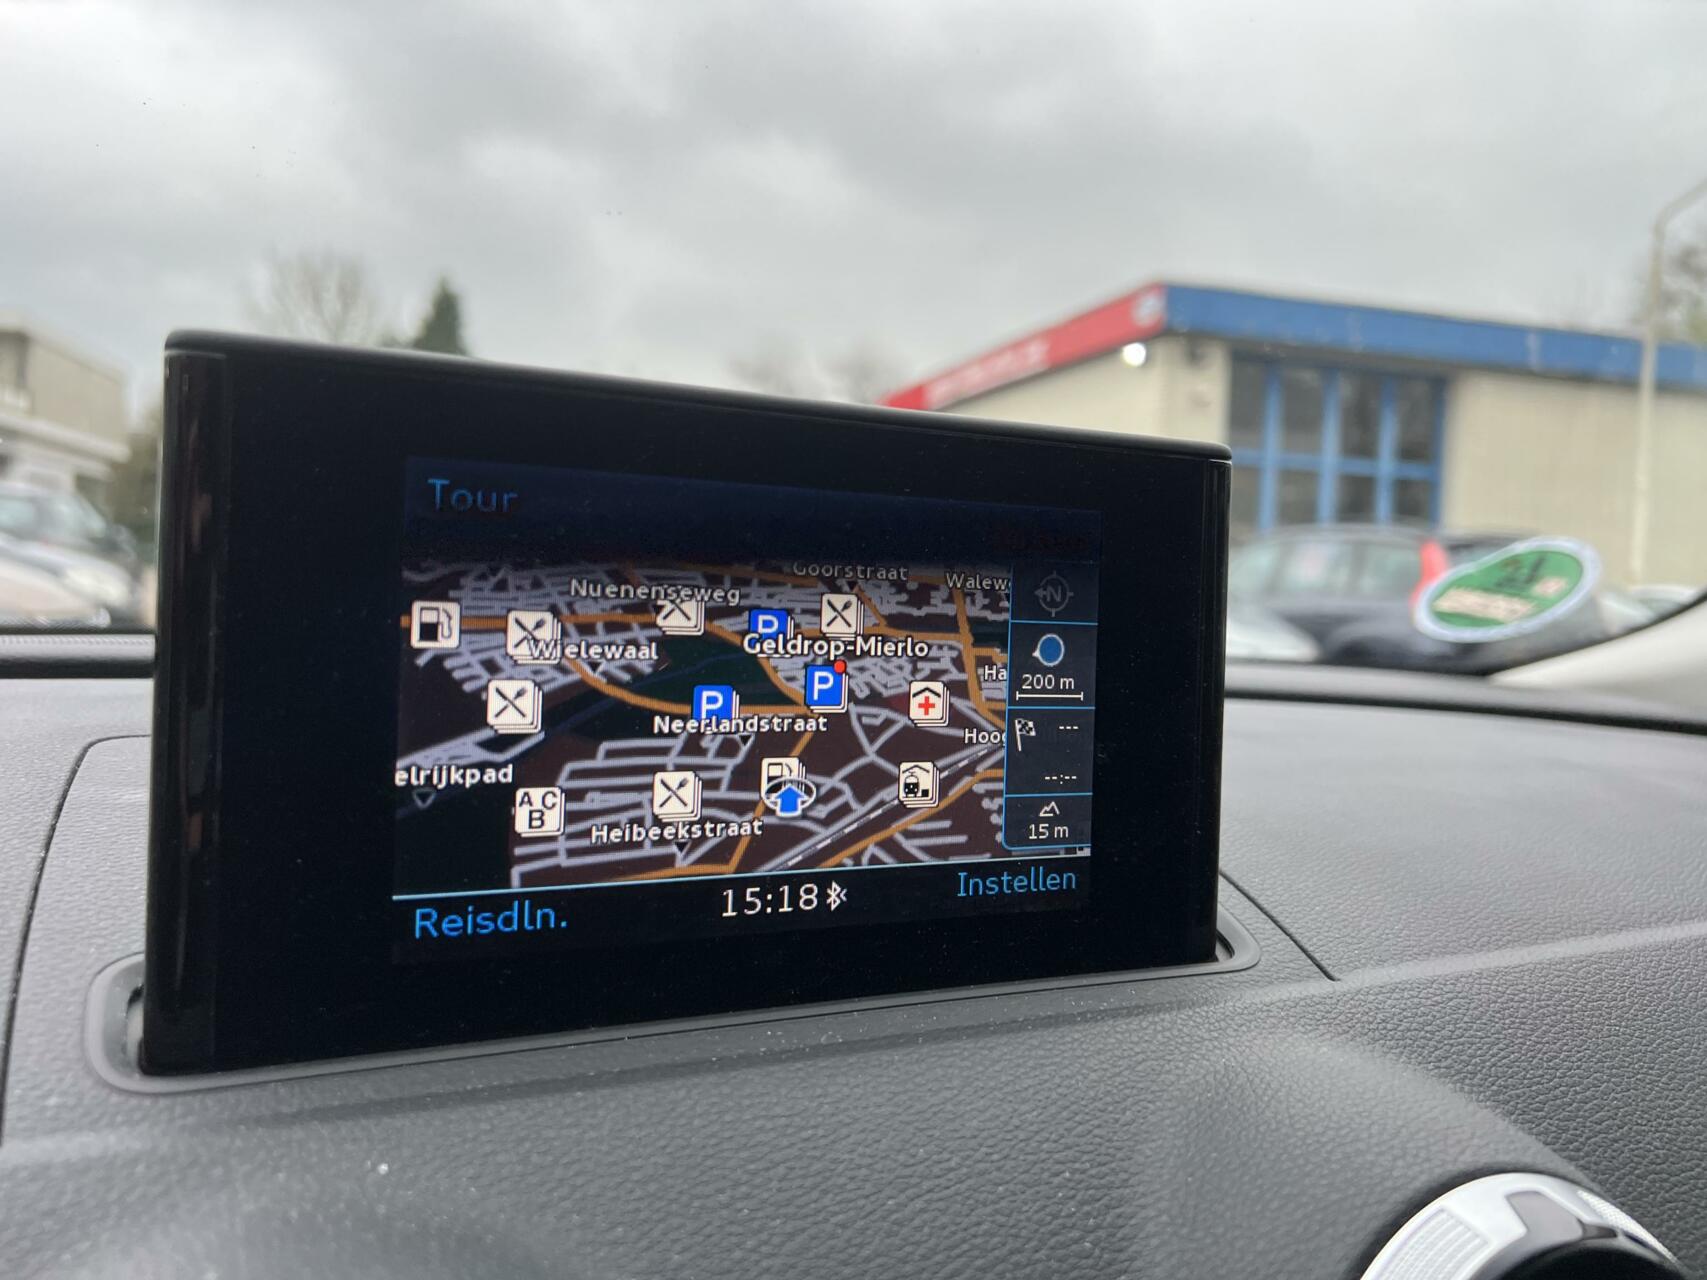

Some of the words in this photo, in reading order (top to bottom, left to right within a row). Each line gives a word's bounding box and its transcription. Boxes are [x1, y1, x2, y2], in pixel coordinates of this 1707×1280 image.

[427, 477, 518, 512] Tour
[793, 561, 909, 582] Goorstraat
[945, 571, 1011, 591] Walew
[570, 578, 741, 606] Nuenenseweg
[530, 639, 659, 661] Wielewaal
[743, 633, 929, 661] Geldrop-Mierlo
[1022, 674, 1055, 690] 200
[1060, 677, 1075, 690] m
[653, 714, 828, 735] Neerlandstraat
[394, 763, 514, 789] elrijkpad
[591, 818, 764, 843] Heibeekstraat
[1028, 824, 1050, 839] 15
[1054, 825, 1070, 839] m
[957, 866, 1077, 897] Instellen
[722, 884, 819, 918] 15:18
[414, 900, 569, 940] Reisdln.
